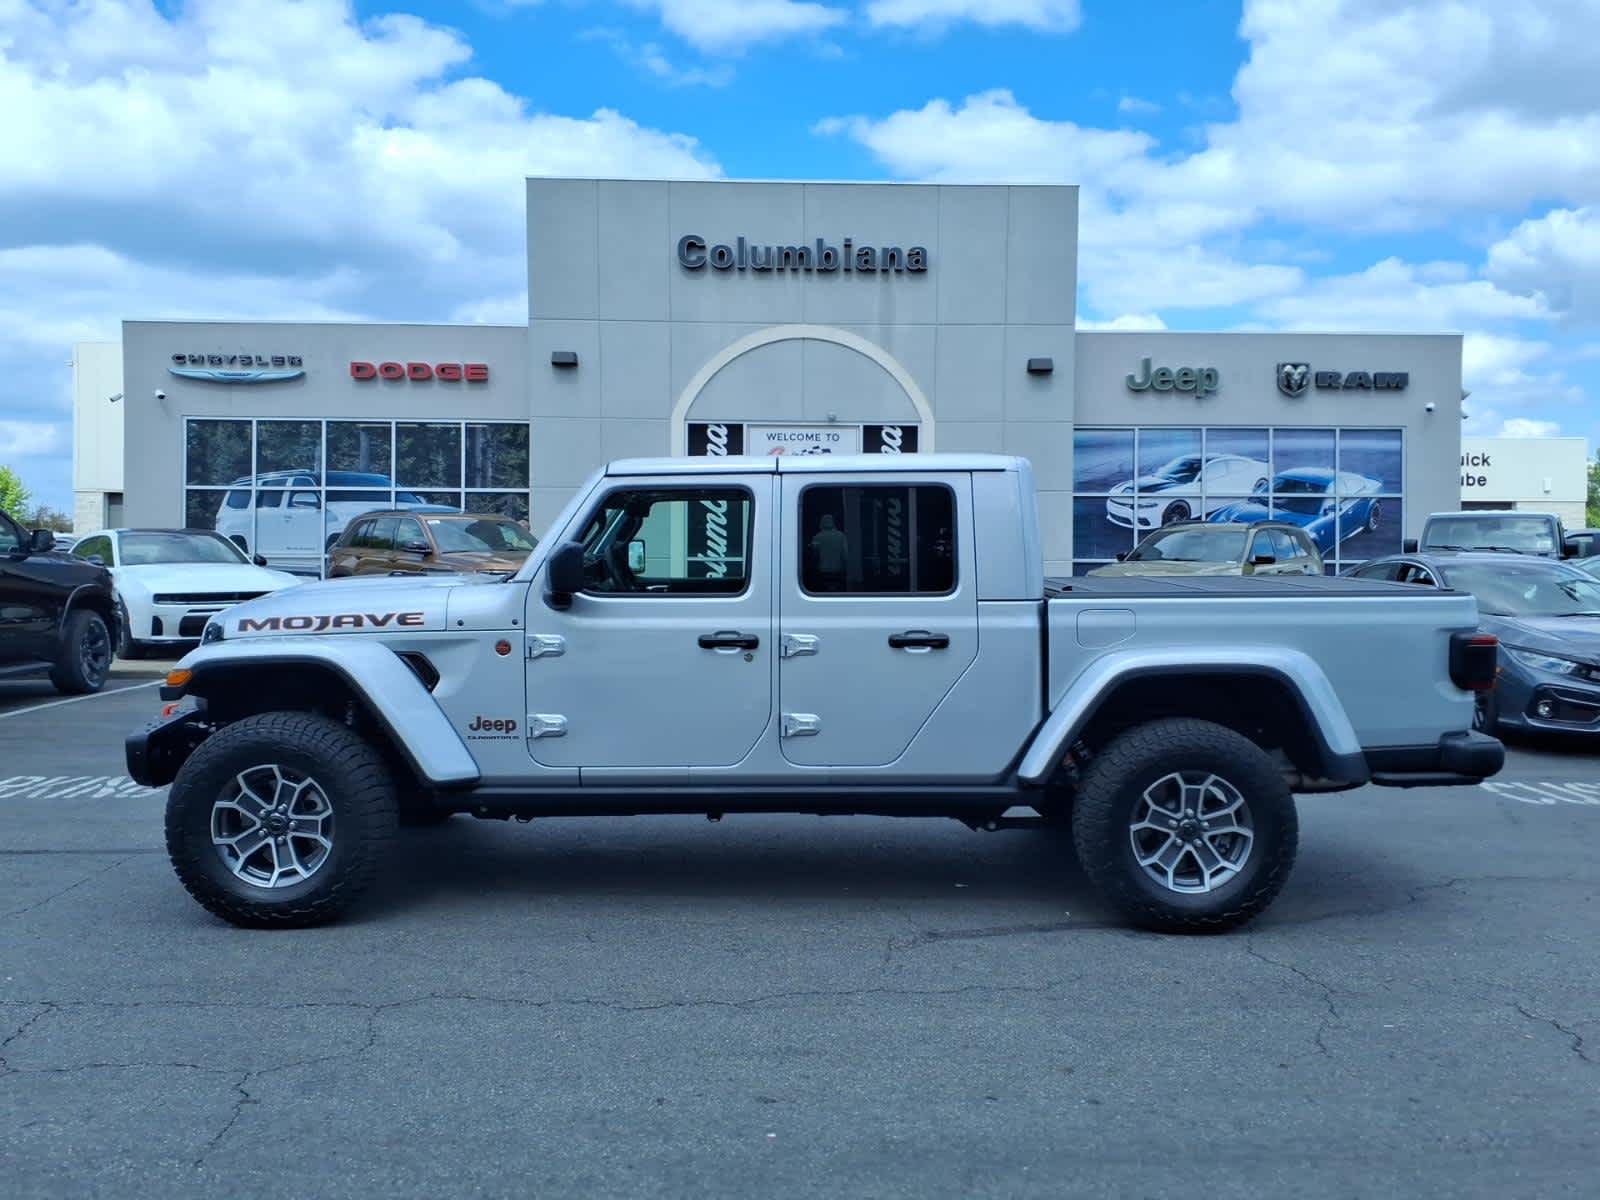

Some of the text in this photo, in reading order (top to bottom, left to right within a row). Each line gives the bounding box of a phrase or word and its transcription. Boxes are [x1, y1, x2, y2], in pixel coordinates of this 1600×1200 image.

[678, 235, 928, 273] Columbiana
[171, 353, 303, 367] CHRYSLER
[350, 361, 489, 382] DODGE
[1126, 357, 1220, 400] Jeep
[1314, 371, 1409, 391] RAM
[766, 432, 840, 442] WELCOME TO
[237, 612, 425, 632] MOJAVE
[468, 715, 517, 734] Jeep
